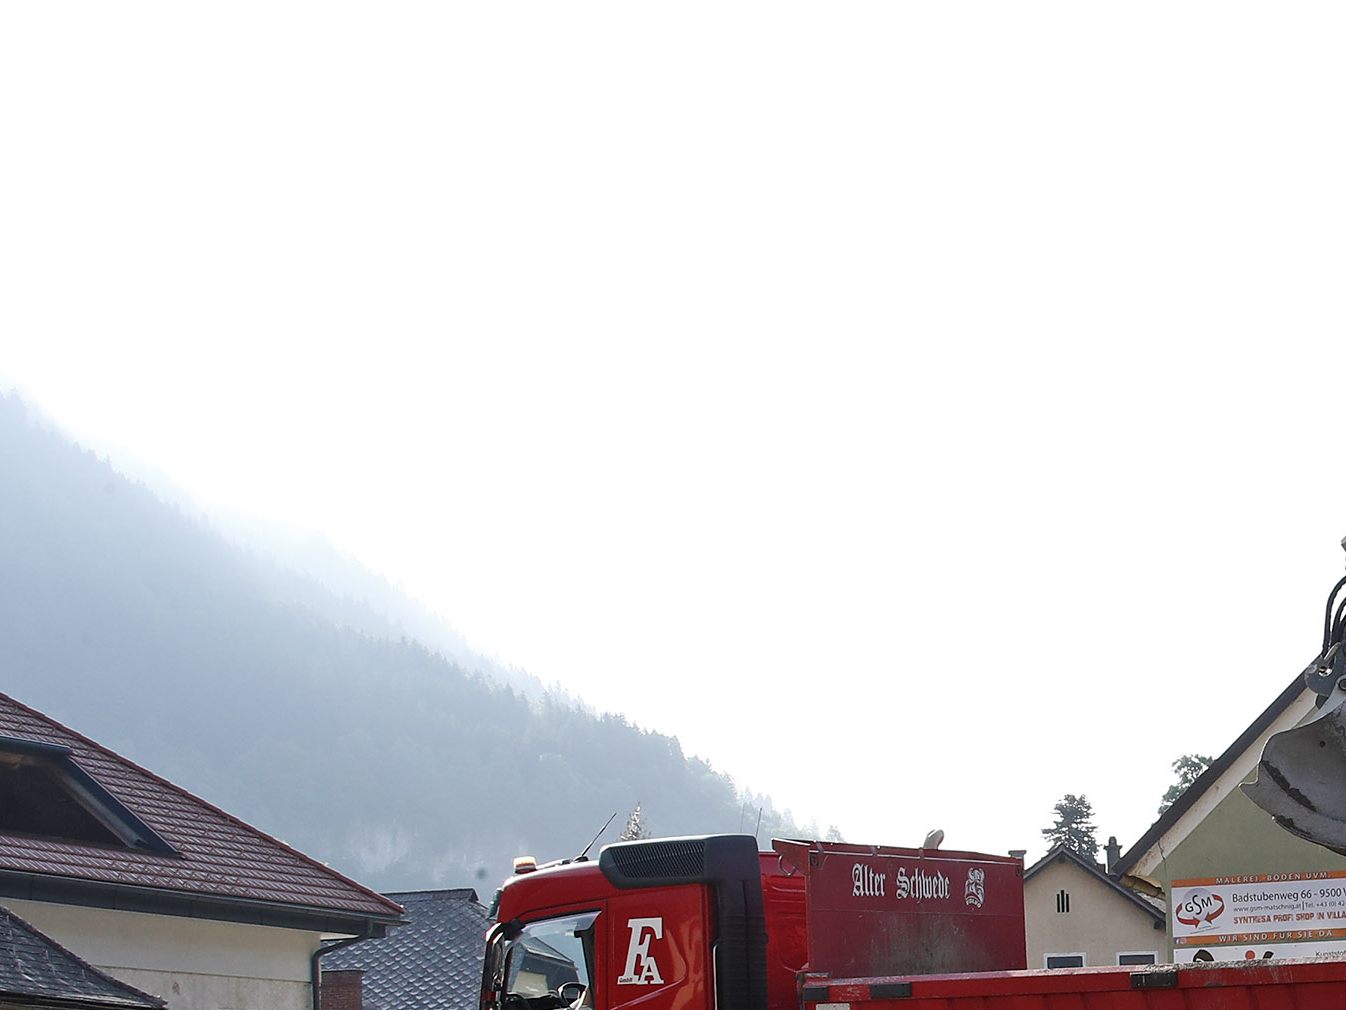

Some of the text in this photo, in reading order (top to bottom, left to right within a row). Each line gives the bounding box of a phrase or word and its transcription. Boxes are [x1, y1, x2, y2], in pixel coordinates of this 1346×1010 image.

[852, 863, 950, 900] Alter Schwede
[1232, 889, 1299, 903] Badstubenweg
[1300, 889, 1313, 899] 66
[1319, 887, 1342, 898] 9500
[1185, 894, 1213, 915] GSM
[1295, 912, 1315, 921] SHOP
[1243, 933, 1267, 941] SIND
[1297, 930, 1313, 938] SIE
[1319, 929, 1333, 937] DA
